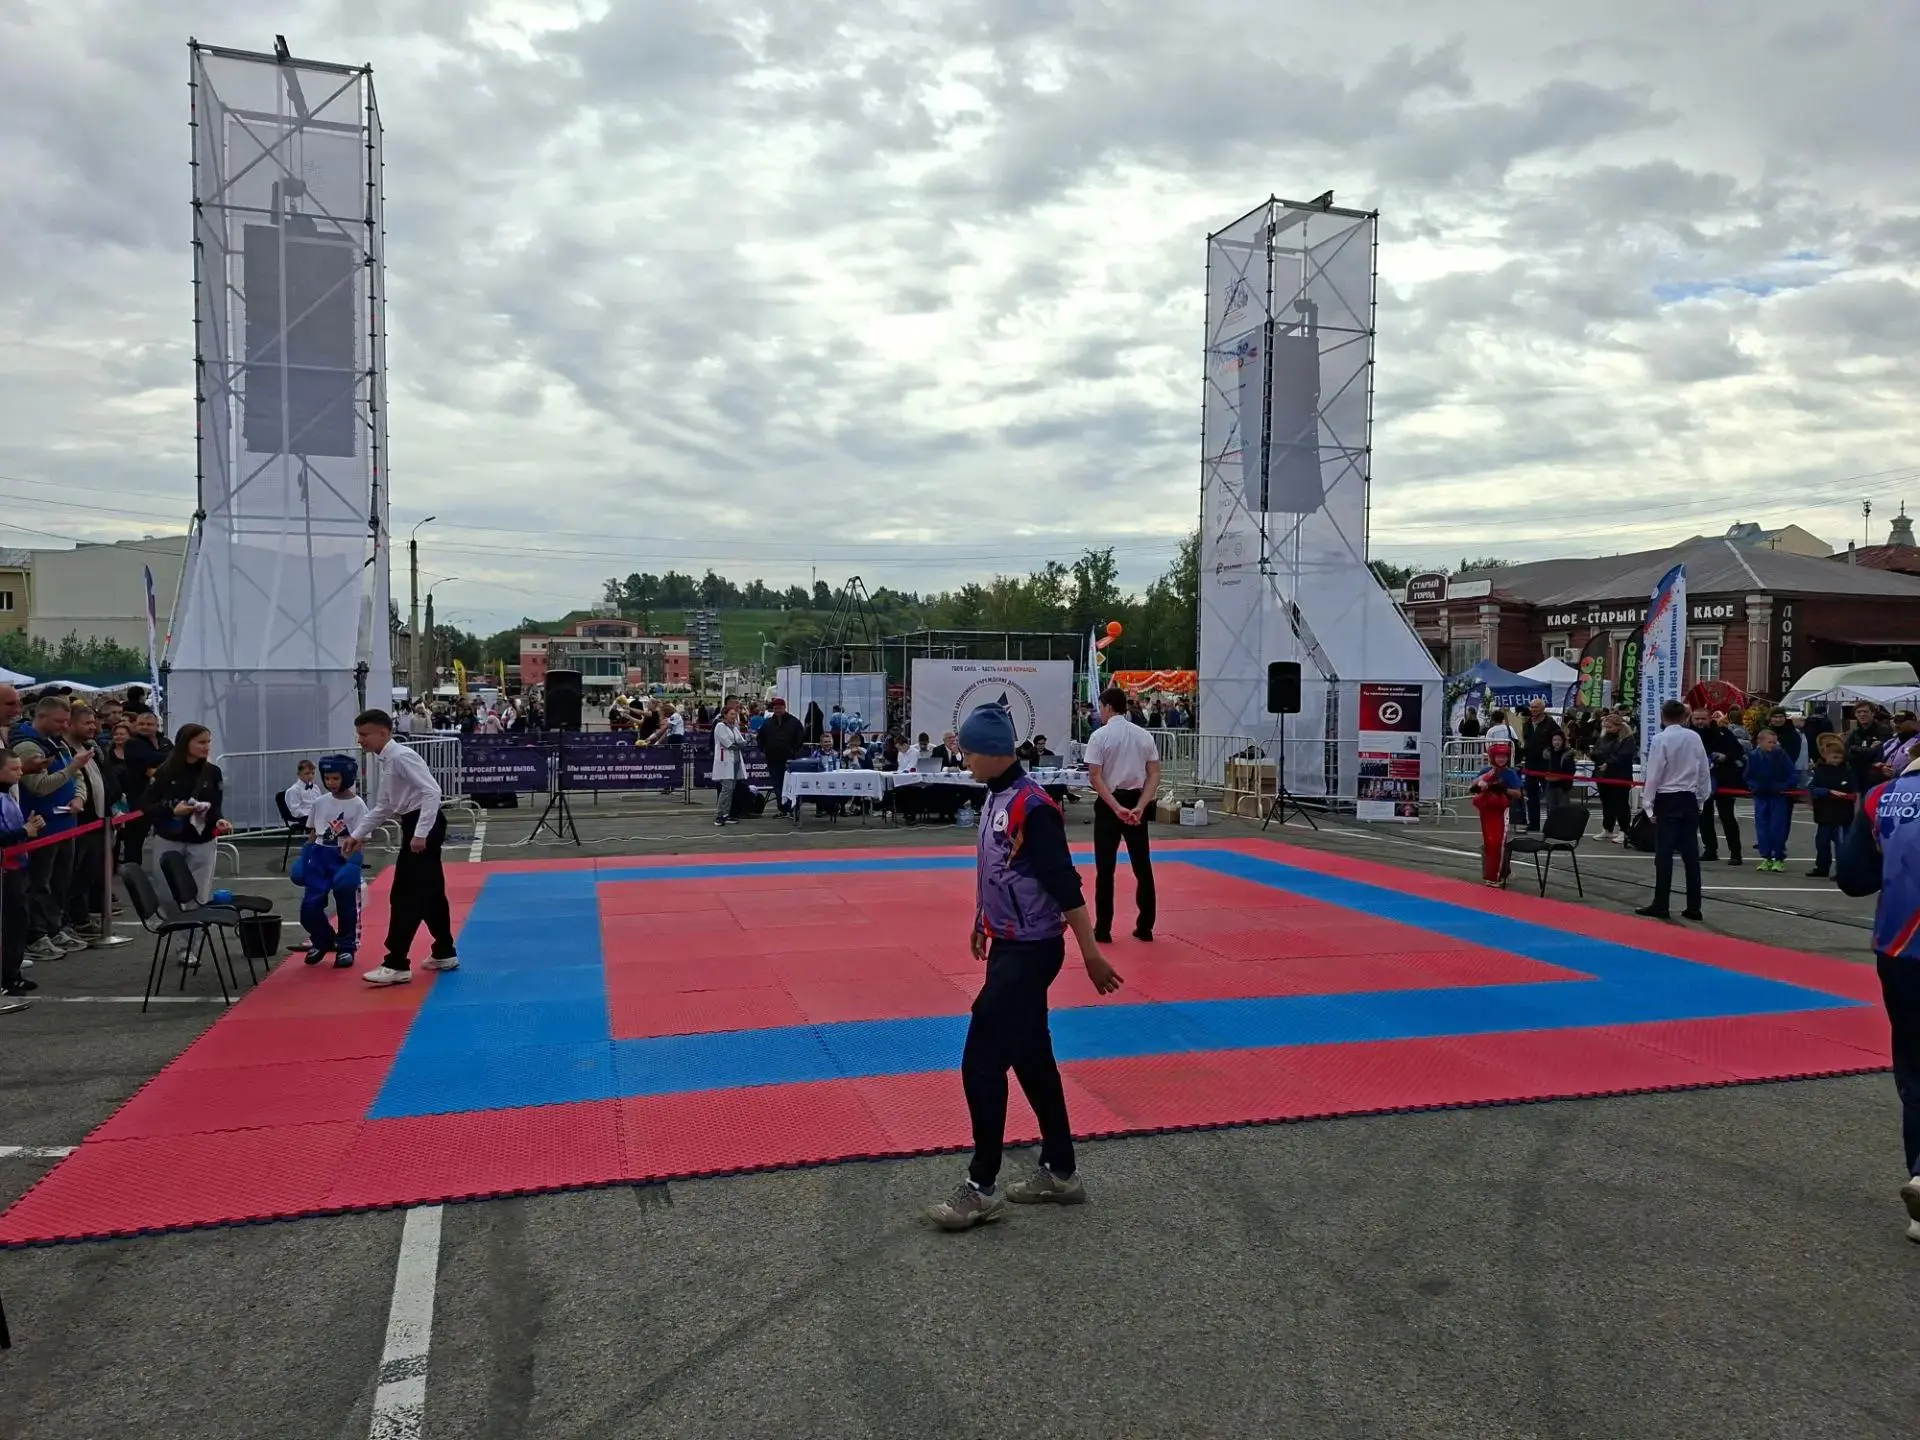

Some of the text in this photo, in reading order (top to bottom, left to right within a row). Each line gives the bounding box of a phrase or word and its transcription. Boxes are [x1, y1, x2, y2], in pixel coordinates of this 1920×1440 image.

[1412, 578, 1440, 590] СТАРЫЙ
[1413, 591, 1436, 600] ГОРОД
[1547, 613, 1578, 626] КАФЕ
[1582, 608, 1636, 624] «СТАРЫЙ
[1693, 604, 1734, 619] КАФЕ
[1781, 605, 1793, 693] ЛОМБАР
[1591, 656, 1604, 707] МИРОВО
[1623, 642, 1638, 706] ИРОВО
[1880, 792, 1920, 803] СПОР
[1879, 806, 1920, 819] ШКО
